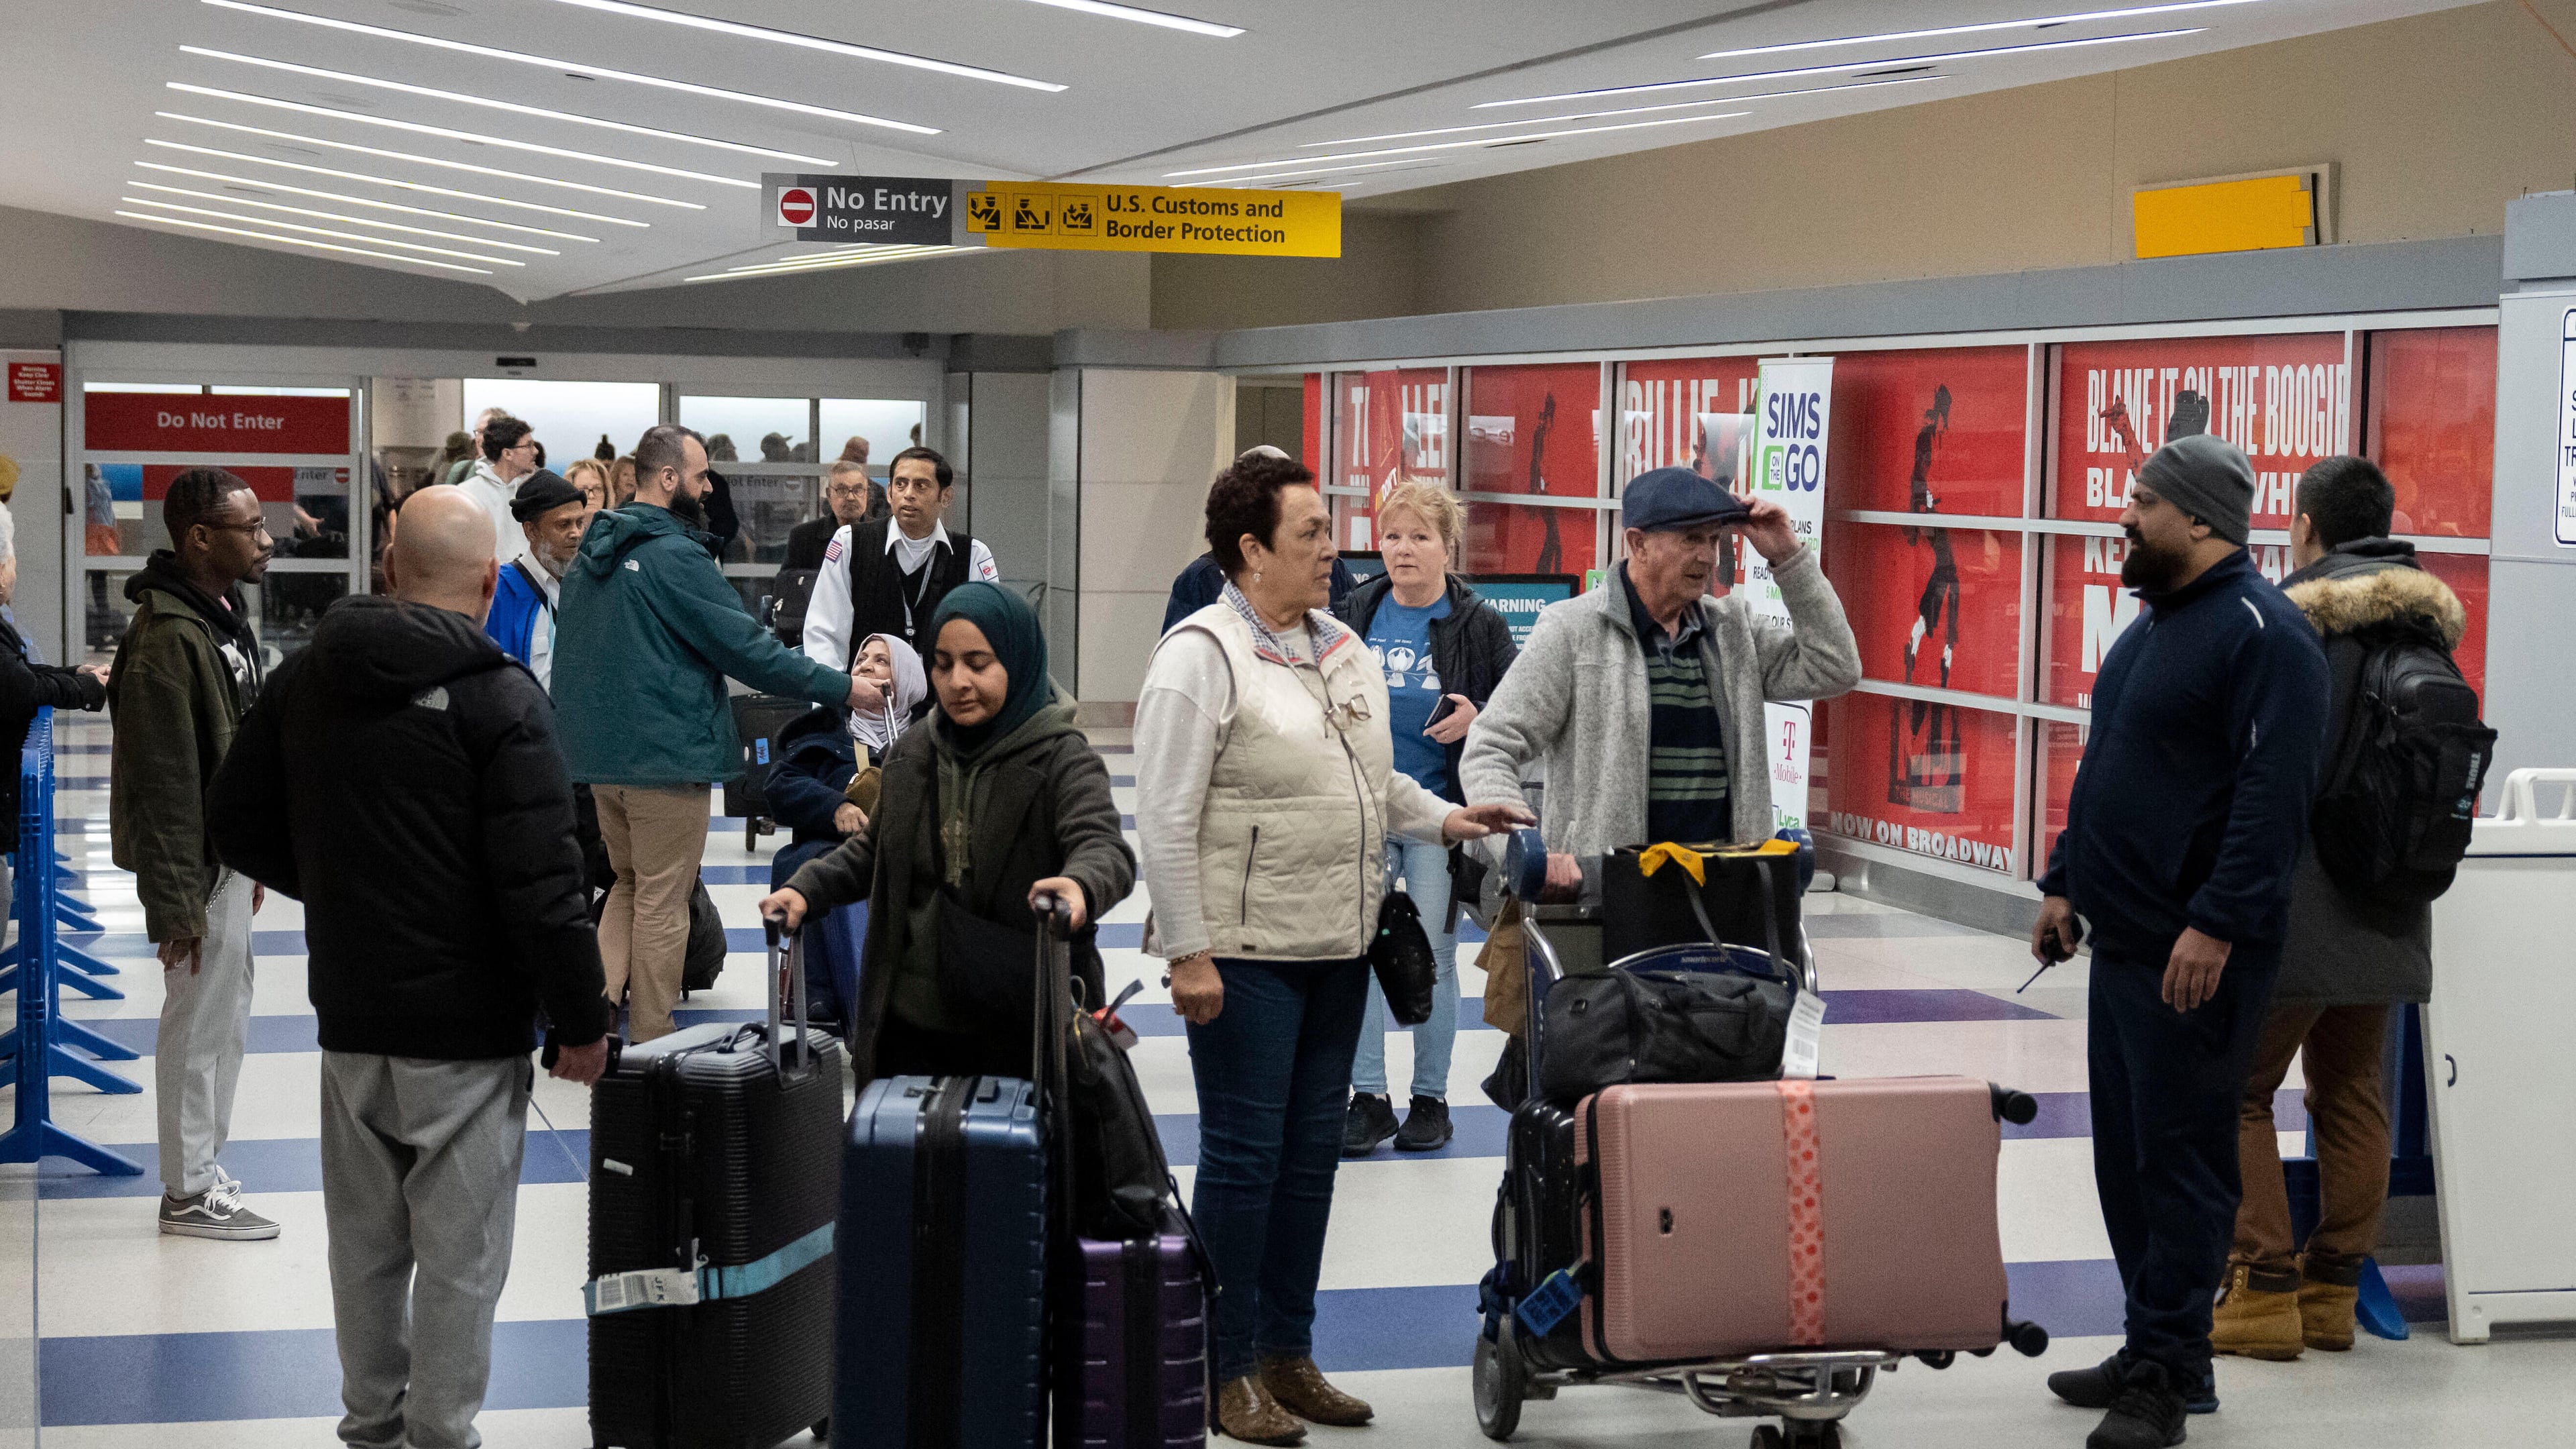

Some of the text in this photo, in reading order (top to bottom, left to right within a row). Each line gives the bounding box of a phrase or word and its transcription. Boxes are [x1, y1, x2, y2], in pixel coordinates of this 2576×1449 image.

[827, 186, 948, 219] No Entry
[1107, 194, 1283, 218] U.S. Customs and
[826, 215, 896, 233] No pasar
[1107, 219, 1285, 244] Border Protection
[157, 411, 284, 431] Do Not Enter
[1767, 392, 1821, 440] SIMS
[2219, 366, 2259, 455] THE
[1772, 455, 1780, 466] ON
[1785, 443, 1820, 492] GO
[1770, 470, 1780, 481] THE
[1485, 598, 1546, 612] ARNING
[1831, 812, 2013, 871] NOW ON BROADWAY
